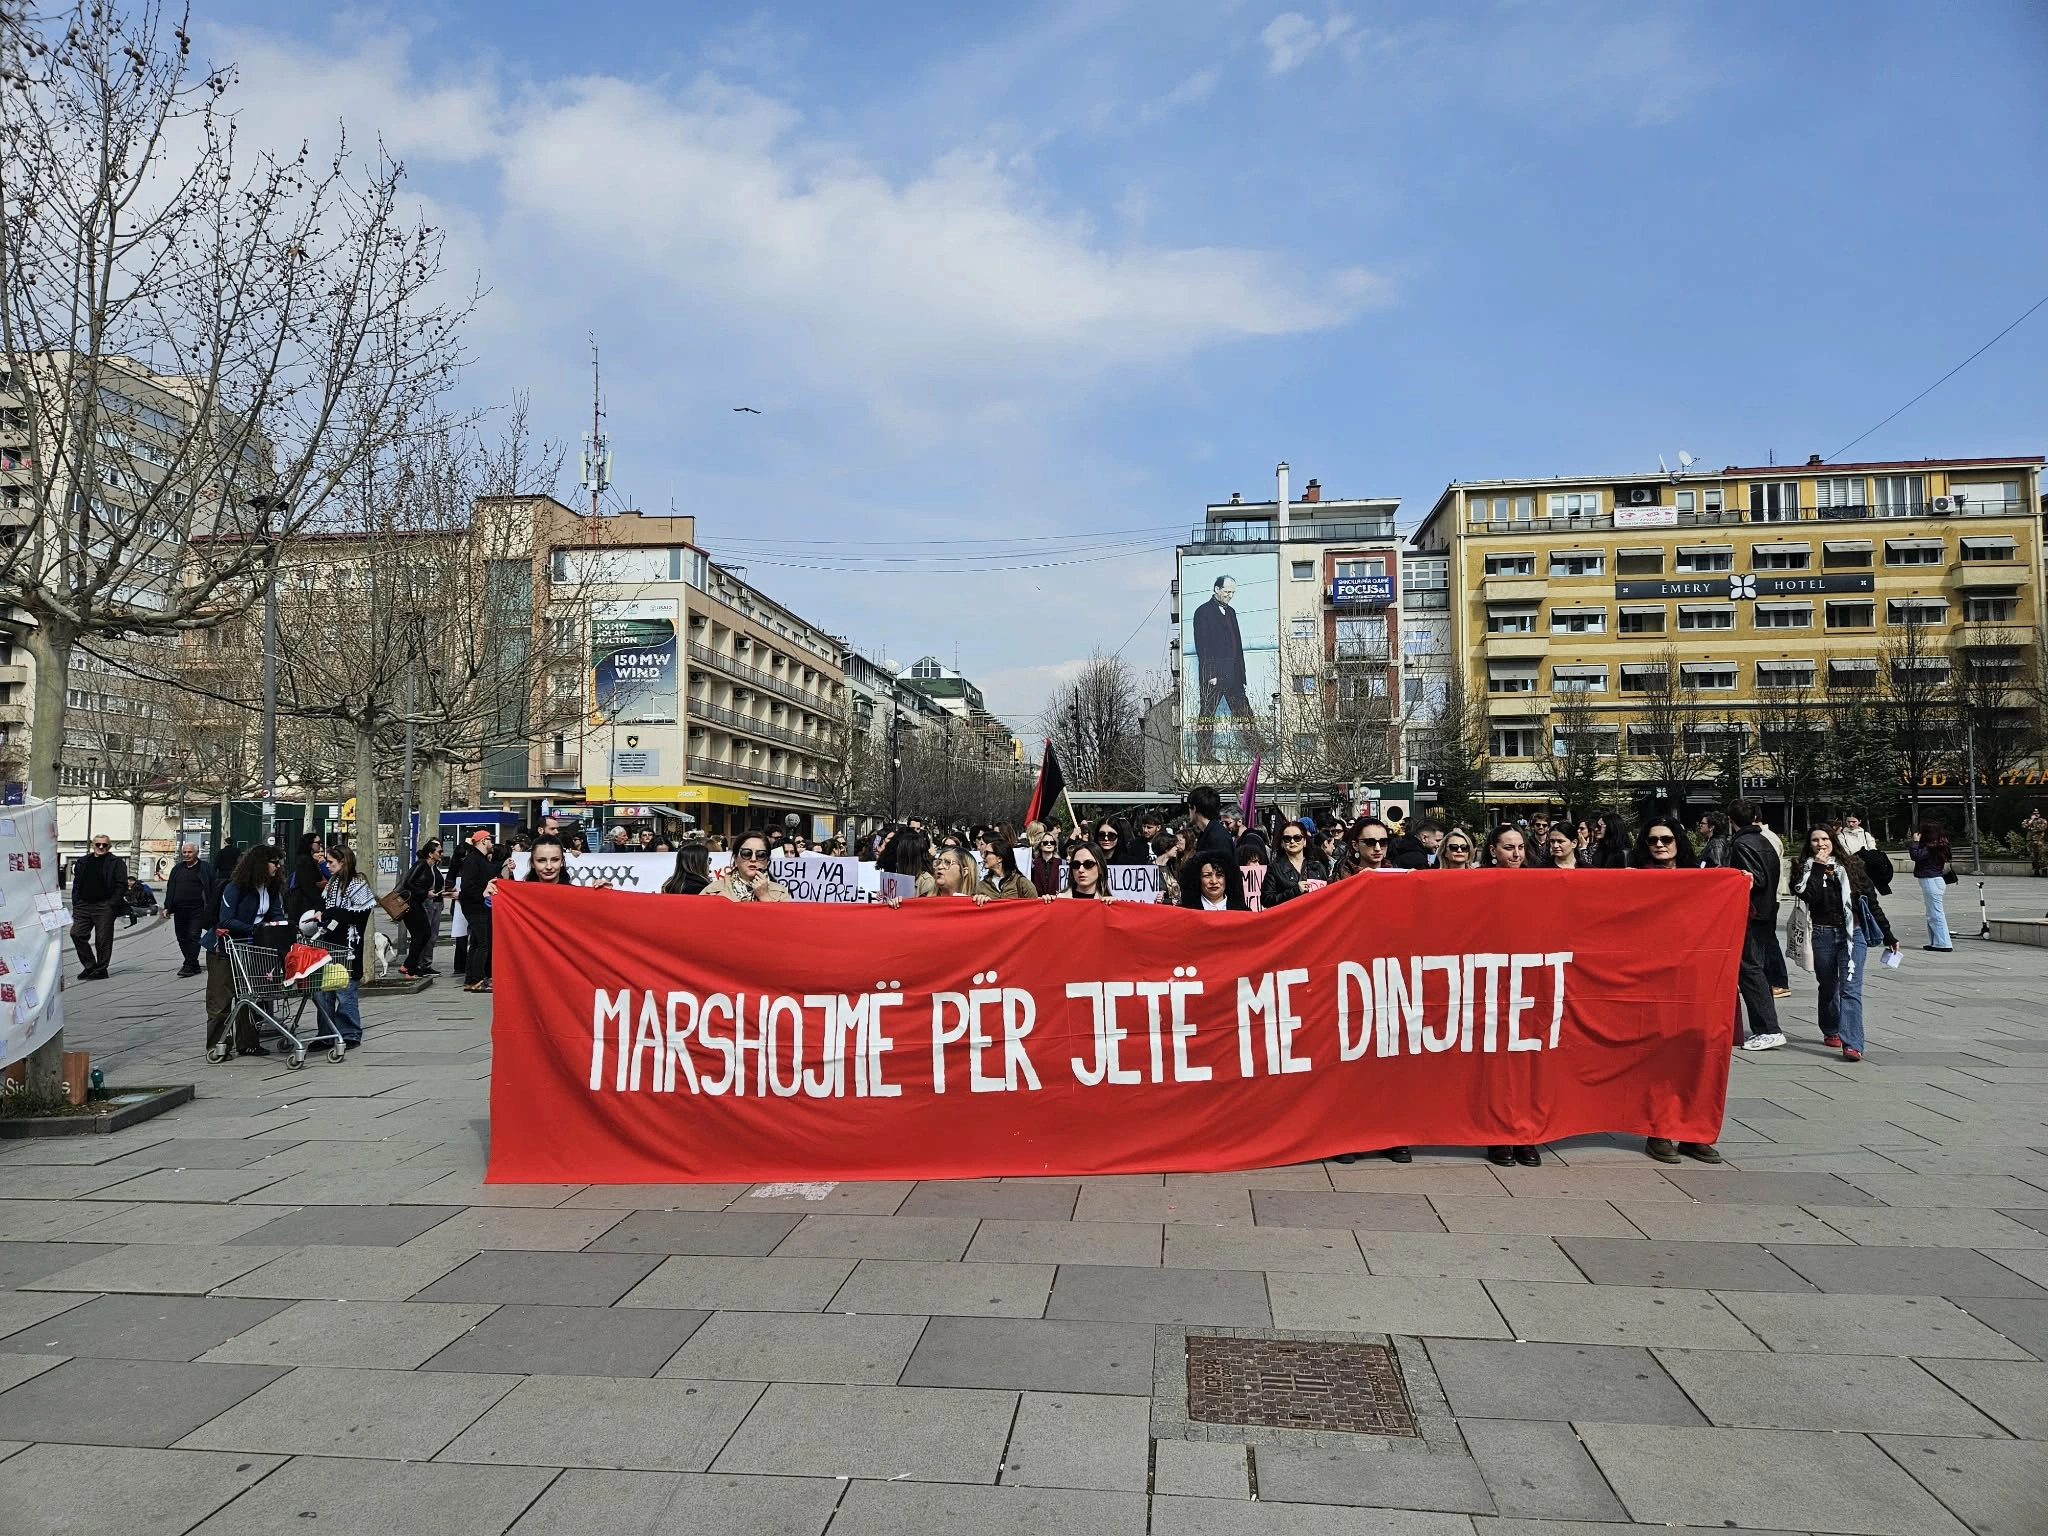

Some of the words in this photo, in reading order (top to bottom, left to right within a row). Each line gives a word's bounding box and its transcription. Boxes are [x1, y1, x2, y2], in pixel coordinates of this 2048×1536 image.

[1661, 584, 1711, 594] EMERY
[1774, 579, 1826, 590] HOTEL
[639, 653, 671, 666] MW
[615, 667, 660, 679] WIND
[816, 862, 844, 885] NA
[590, 980, 904, 1098] MARSHOJMË
[932, 970, 1042, 1094] PËR
[1065, 966, 1213, 1087] JETË
[1237, 968, 1312, 1078] ME
[1338, 951, 1574, 1062] DINJITET
